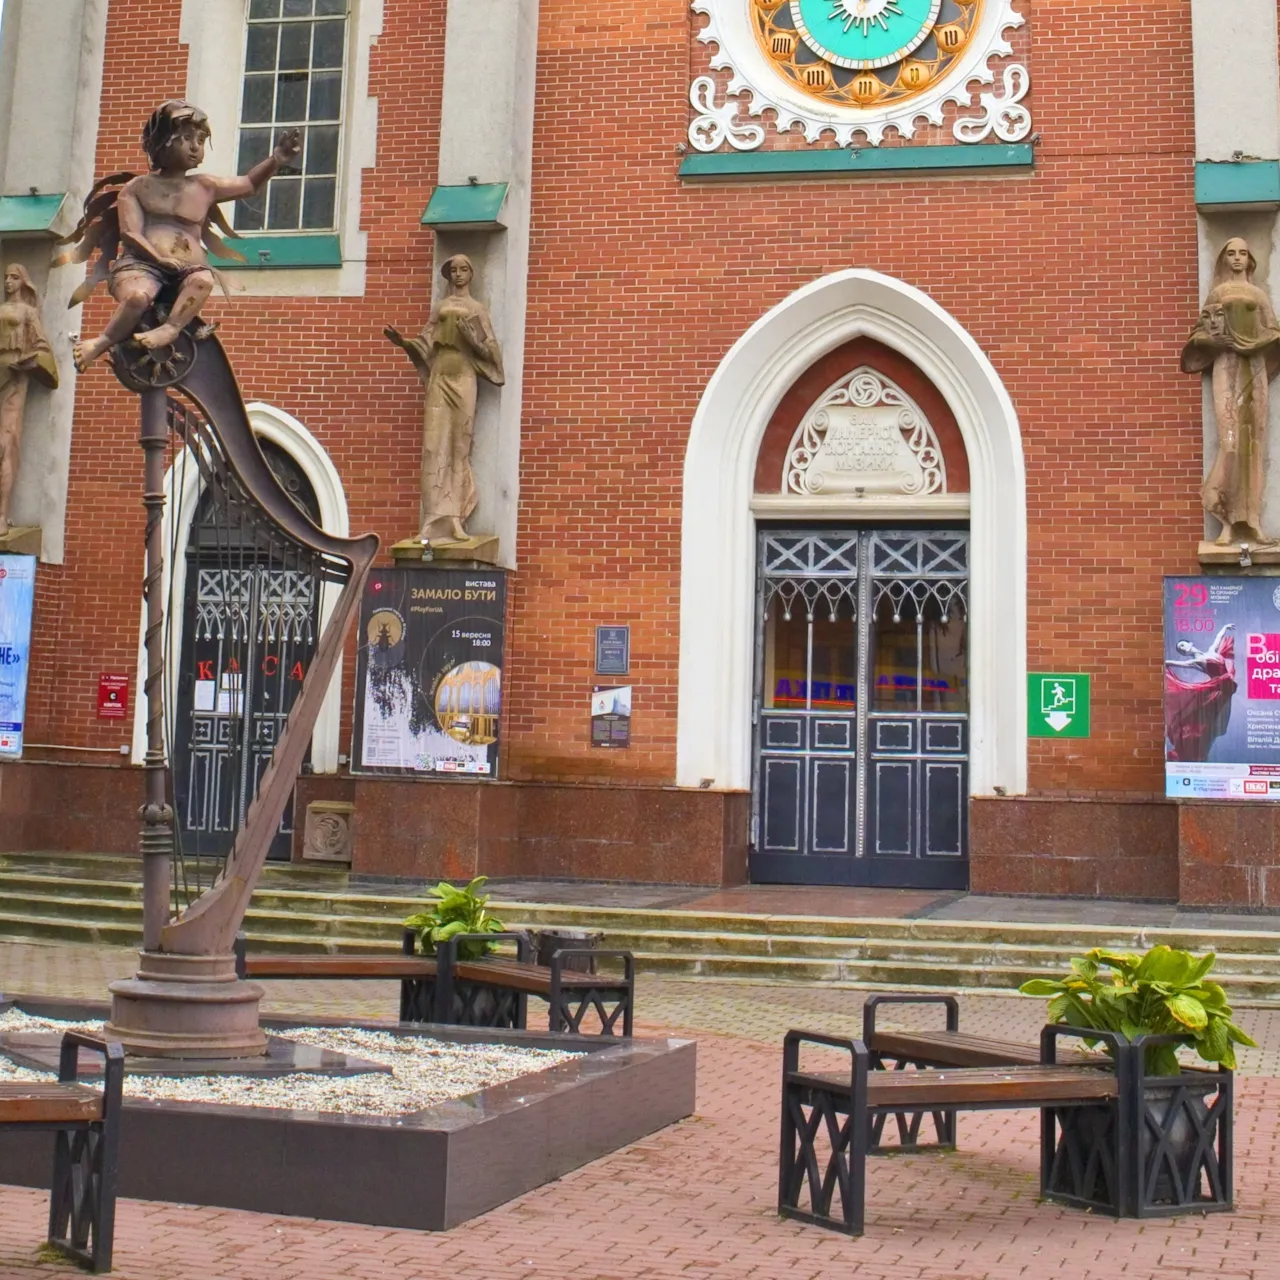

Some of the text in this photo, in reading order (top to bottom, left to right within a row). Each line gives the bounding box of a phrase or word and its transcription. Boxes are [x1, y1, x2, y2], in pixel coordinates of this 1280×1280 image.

[465, 580, 496, 588] вистава
[411, 588, 496, 601] ЗАМАЛО БУТИ
[1173, 583, 1208, 607] 29
[1175, 620, 1214, 632] 18.00
[451, 630, 461, 638] 15
[472, 639, 492, 647] 18:00
[1246, 633, 1267, 658] В
